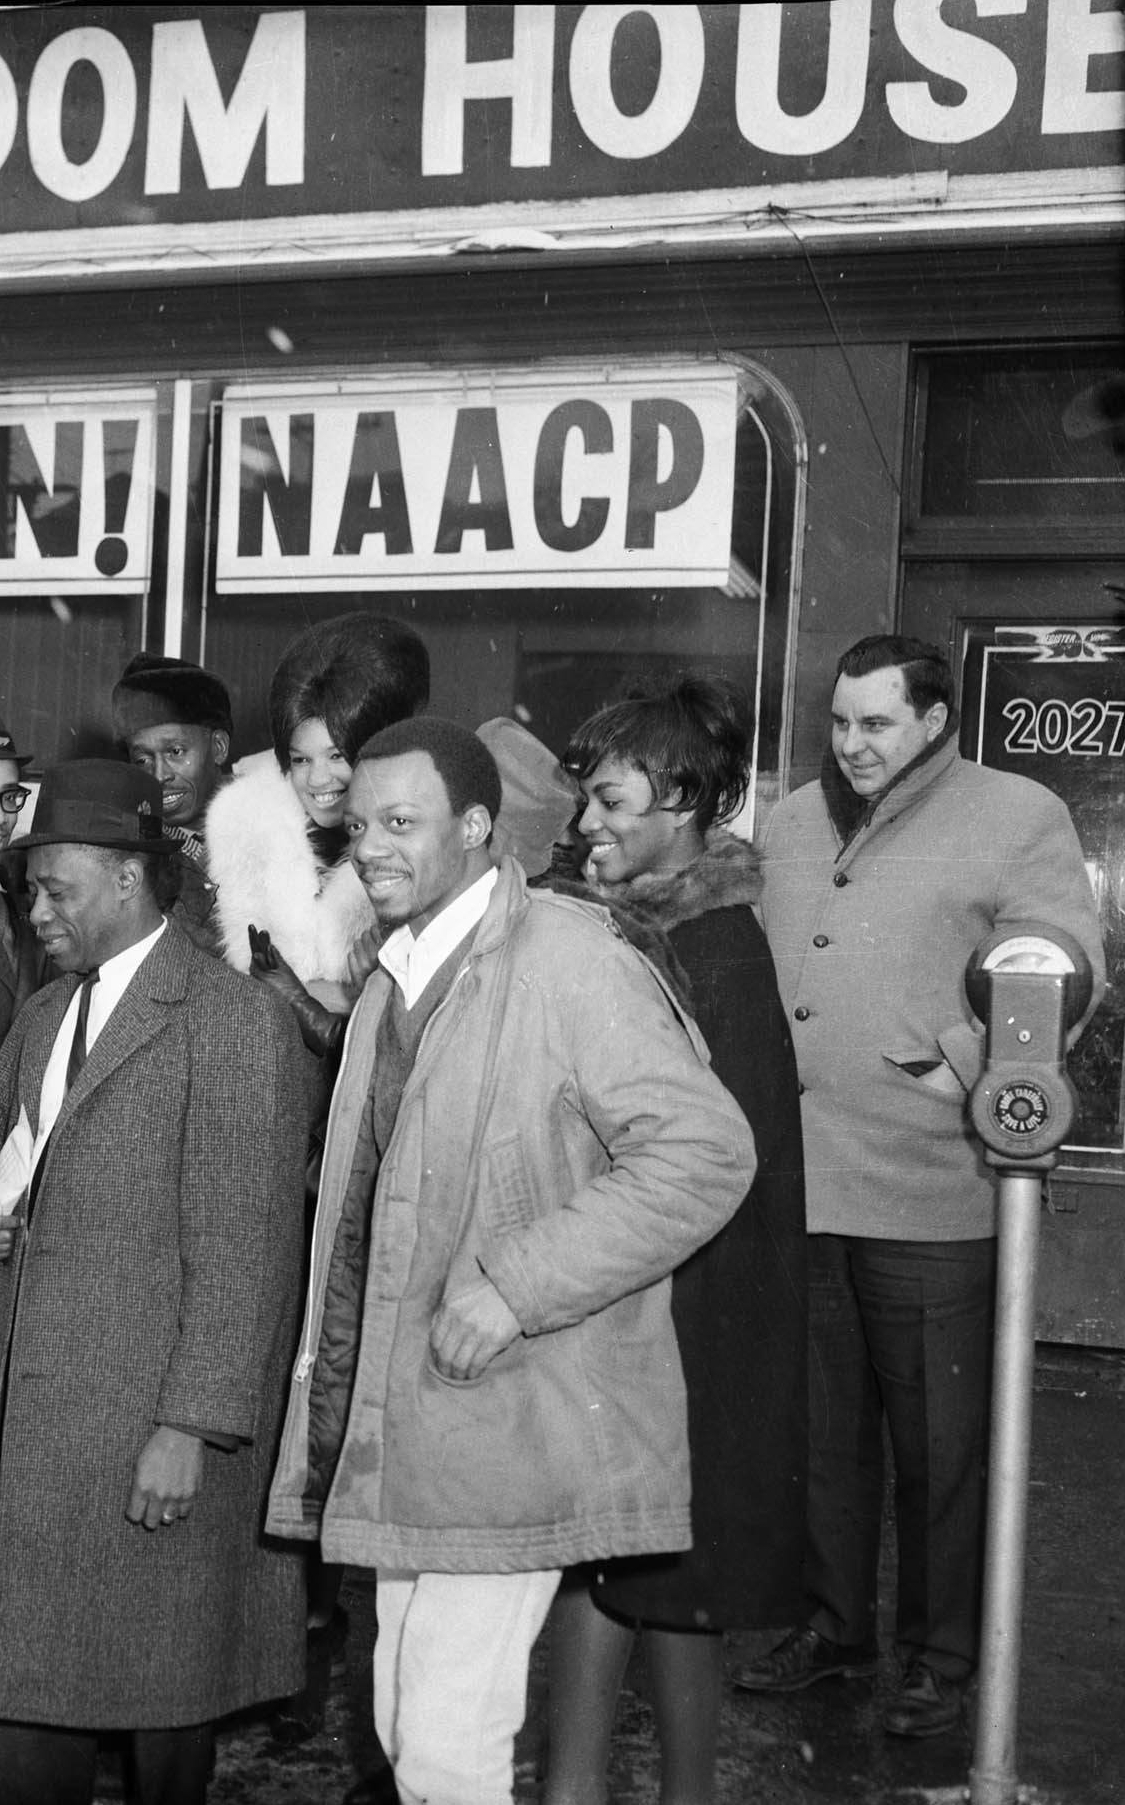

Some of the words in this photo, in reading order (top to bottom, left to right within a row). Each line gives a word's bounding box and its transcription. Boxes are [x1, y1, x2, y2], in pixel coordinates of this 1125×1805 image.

[421, 3, 1125, 177] HOUSE
[237, 398, 705, 557] NAACP
[1002, 698, 1125, 757] 2027
